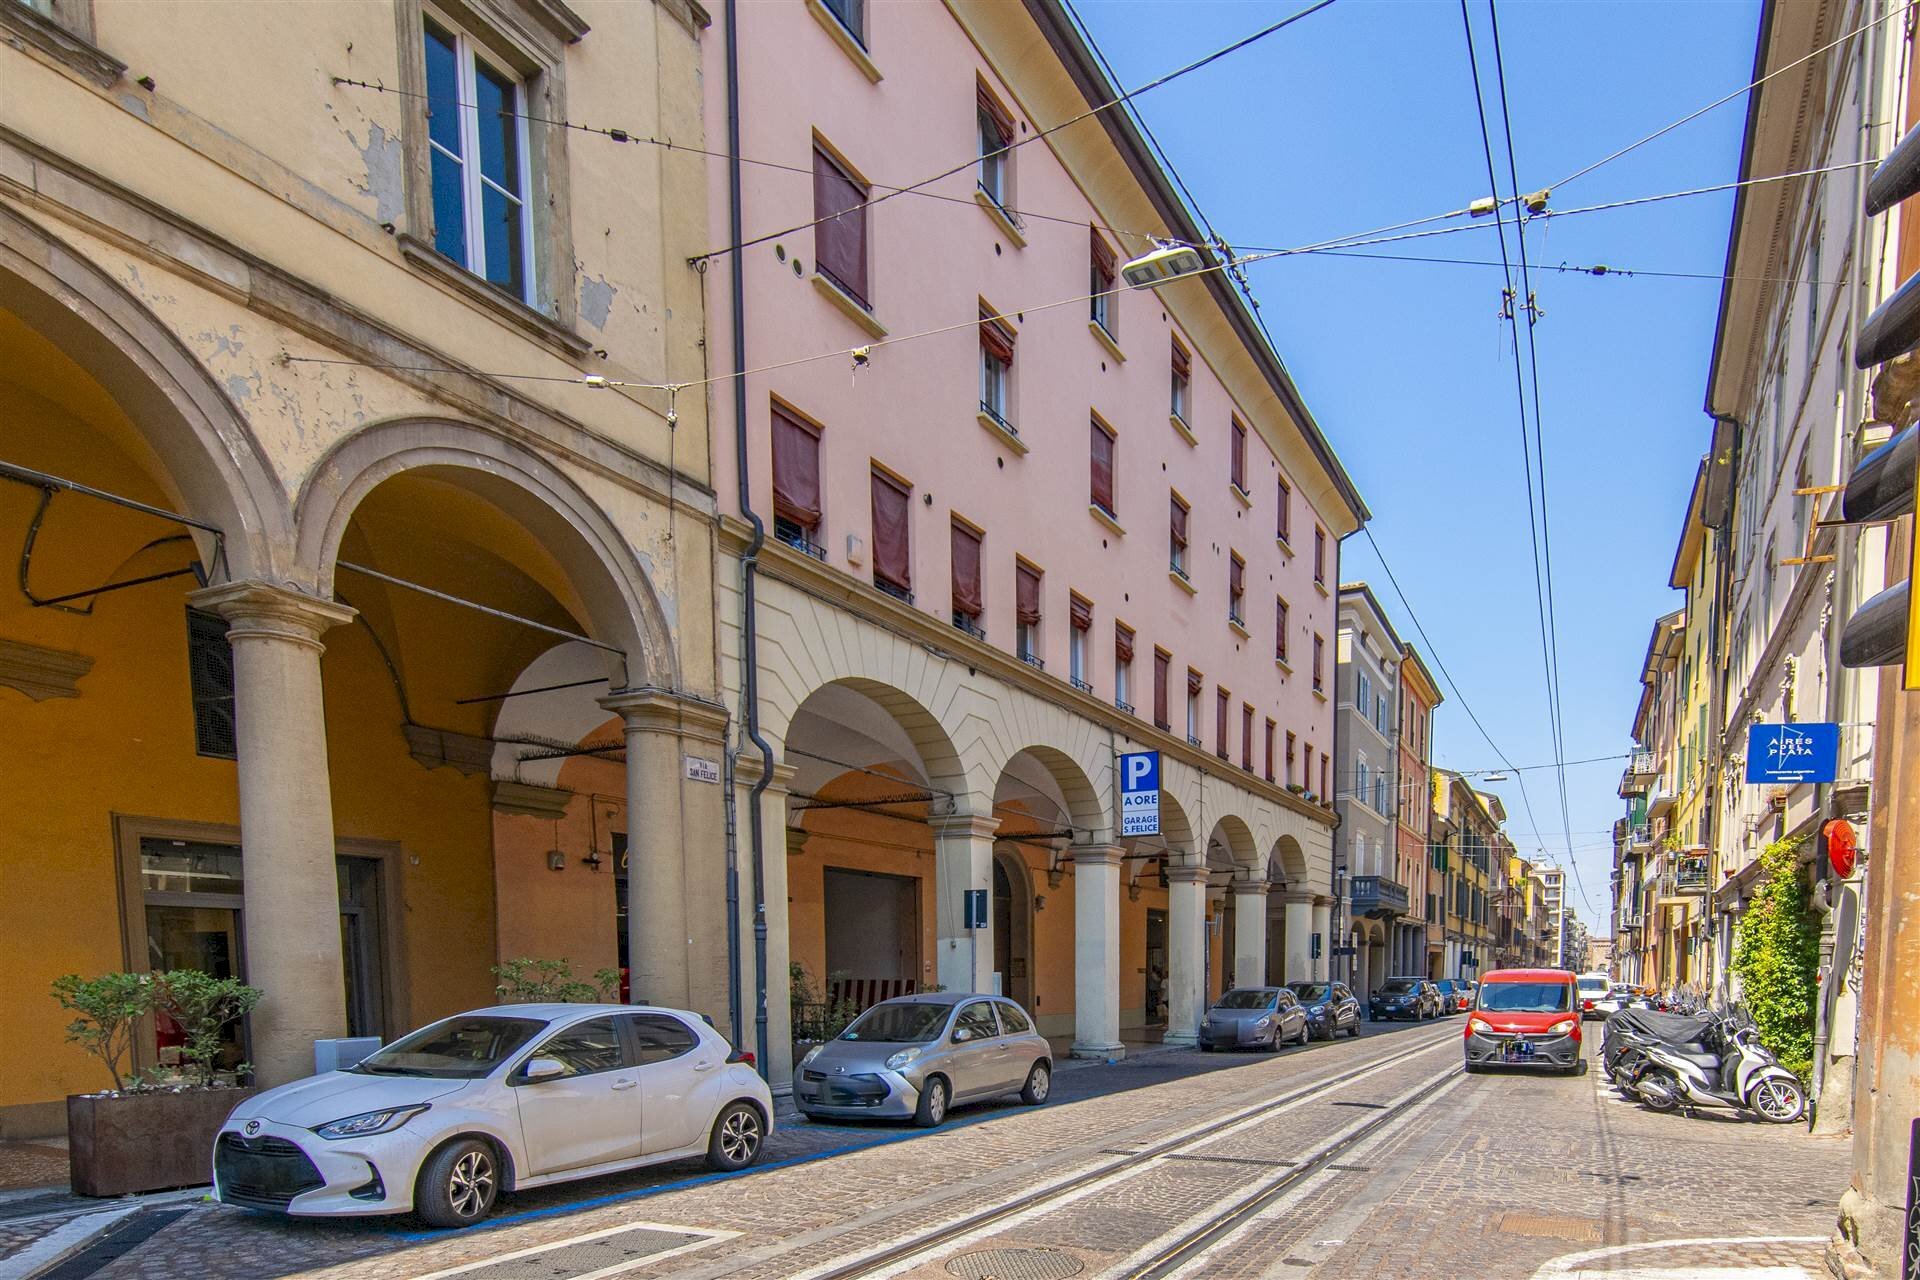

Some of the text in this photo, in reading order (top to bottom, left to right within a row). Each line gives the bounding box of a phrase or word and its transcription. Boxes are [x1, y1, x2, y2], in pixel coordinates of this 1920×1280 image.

[690, 767, 718, 781] SAN FELICE
[1128, 756, 1152, 790] P
[1124, 794, 1157, 806] A ORE
[1124, 815, 1157, 824] GARAGE
[1131, 823, 1157, 833] FELICE
